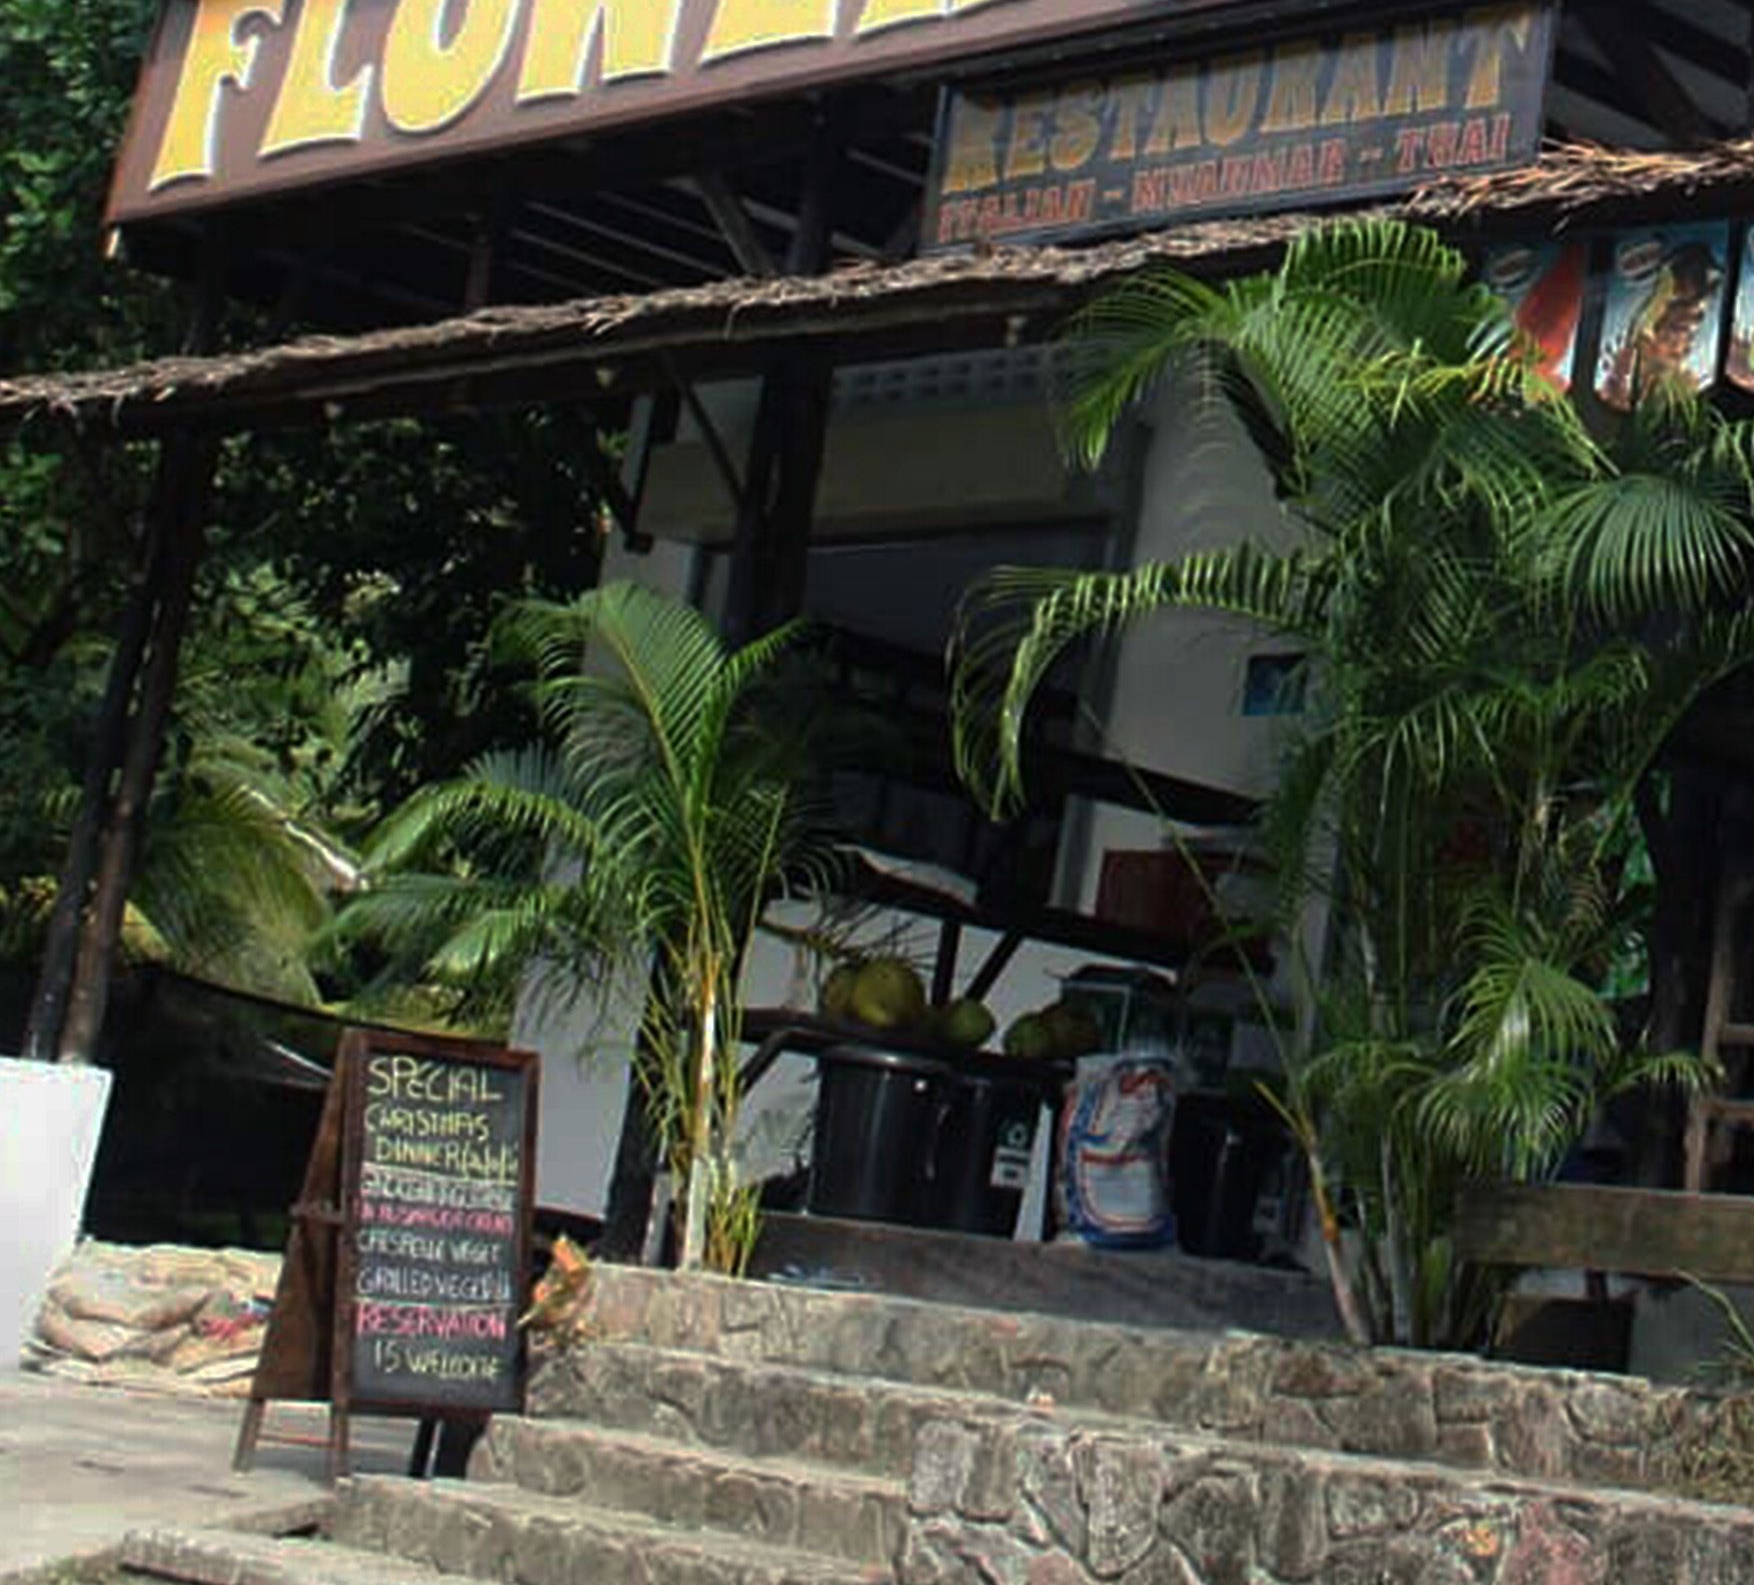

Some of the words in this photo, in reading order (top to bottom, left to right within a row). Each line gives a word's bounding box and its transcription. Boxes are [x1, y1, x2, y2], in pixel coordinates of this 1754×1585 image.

[942, 2, 1534, 195] RESTAURANT
[1397, 110, 1511, 174] THAI
[367, 1056, 503, 1102] SPECIAL
[356, 1302, 507, 1343] RESERVATION
